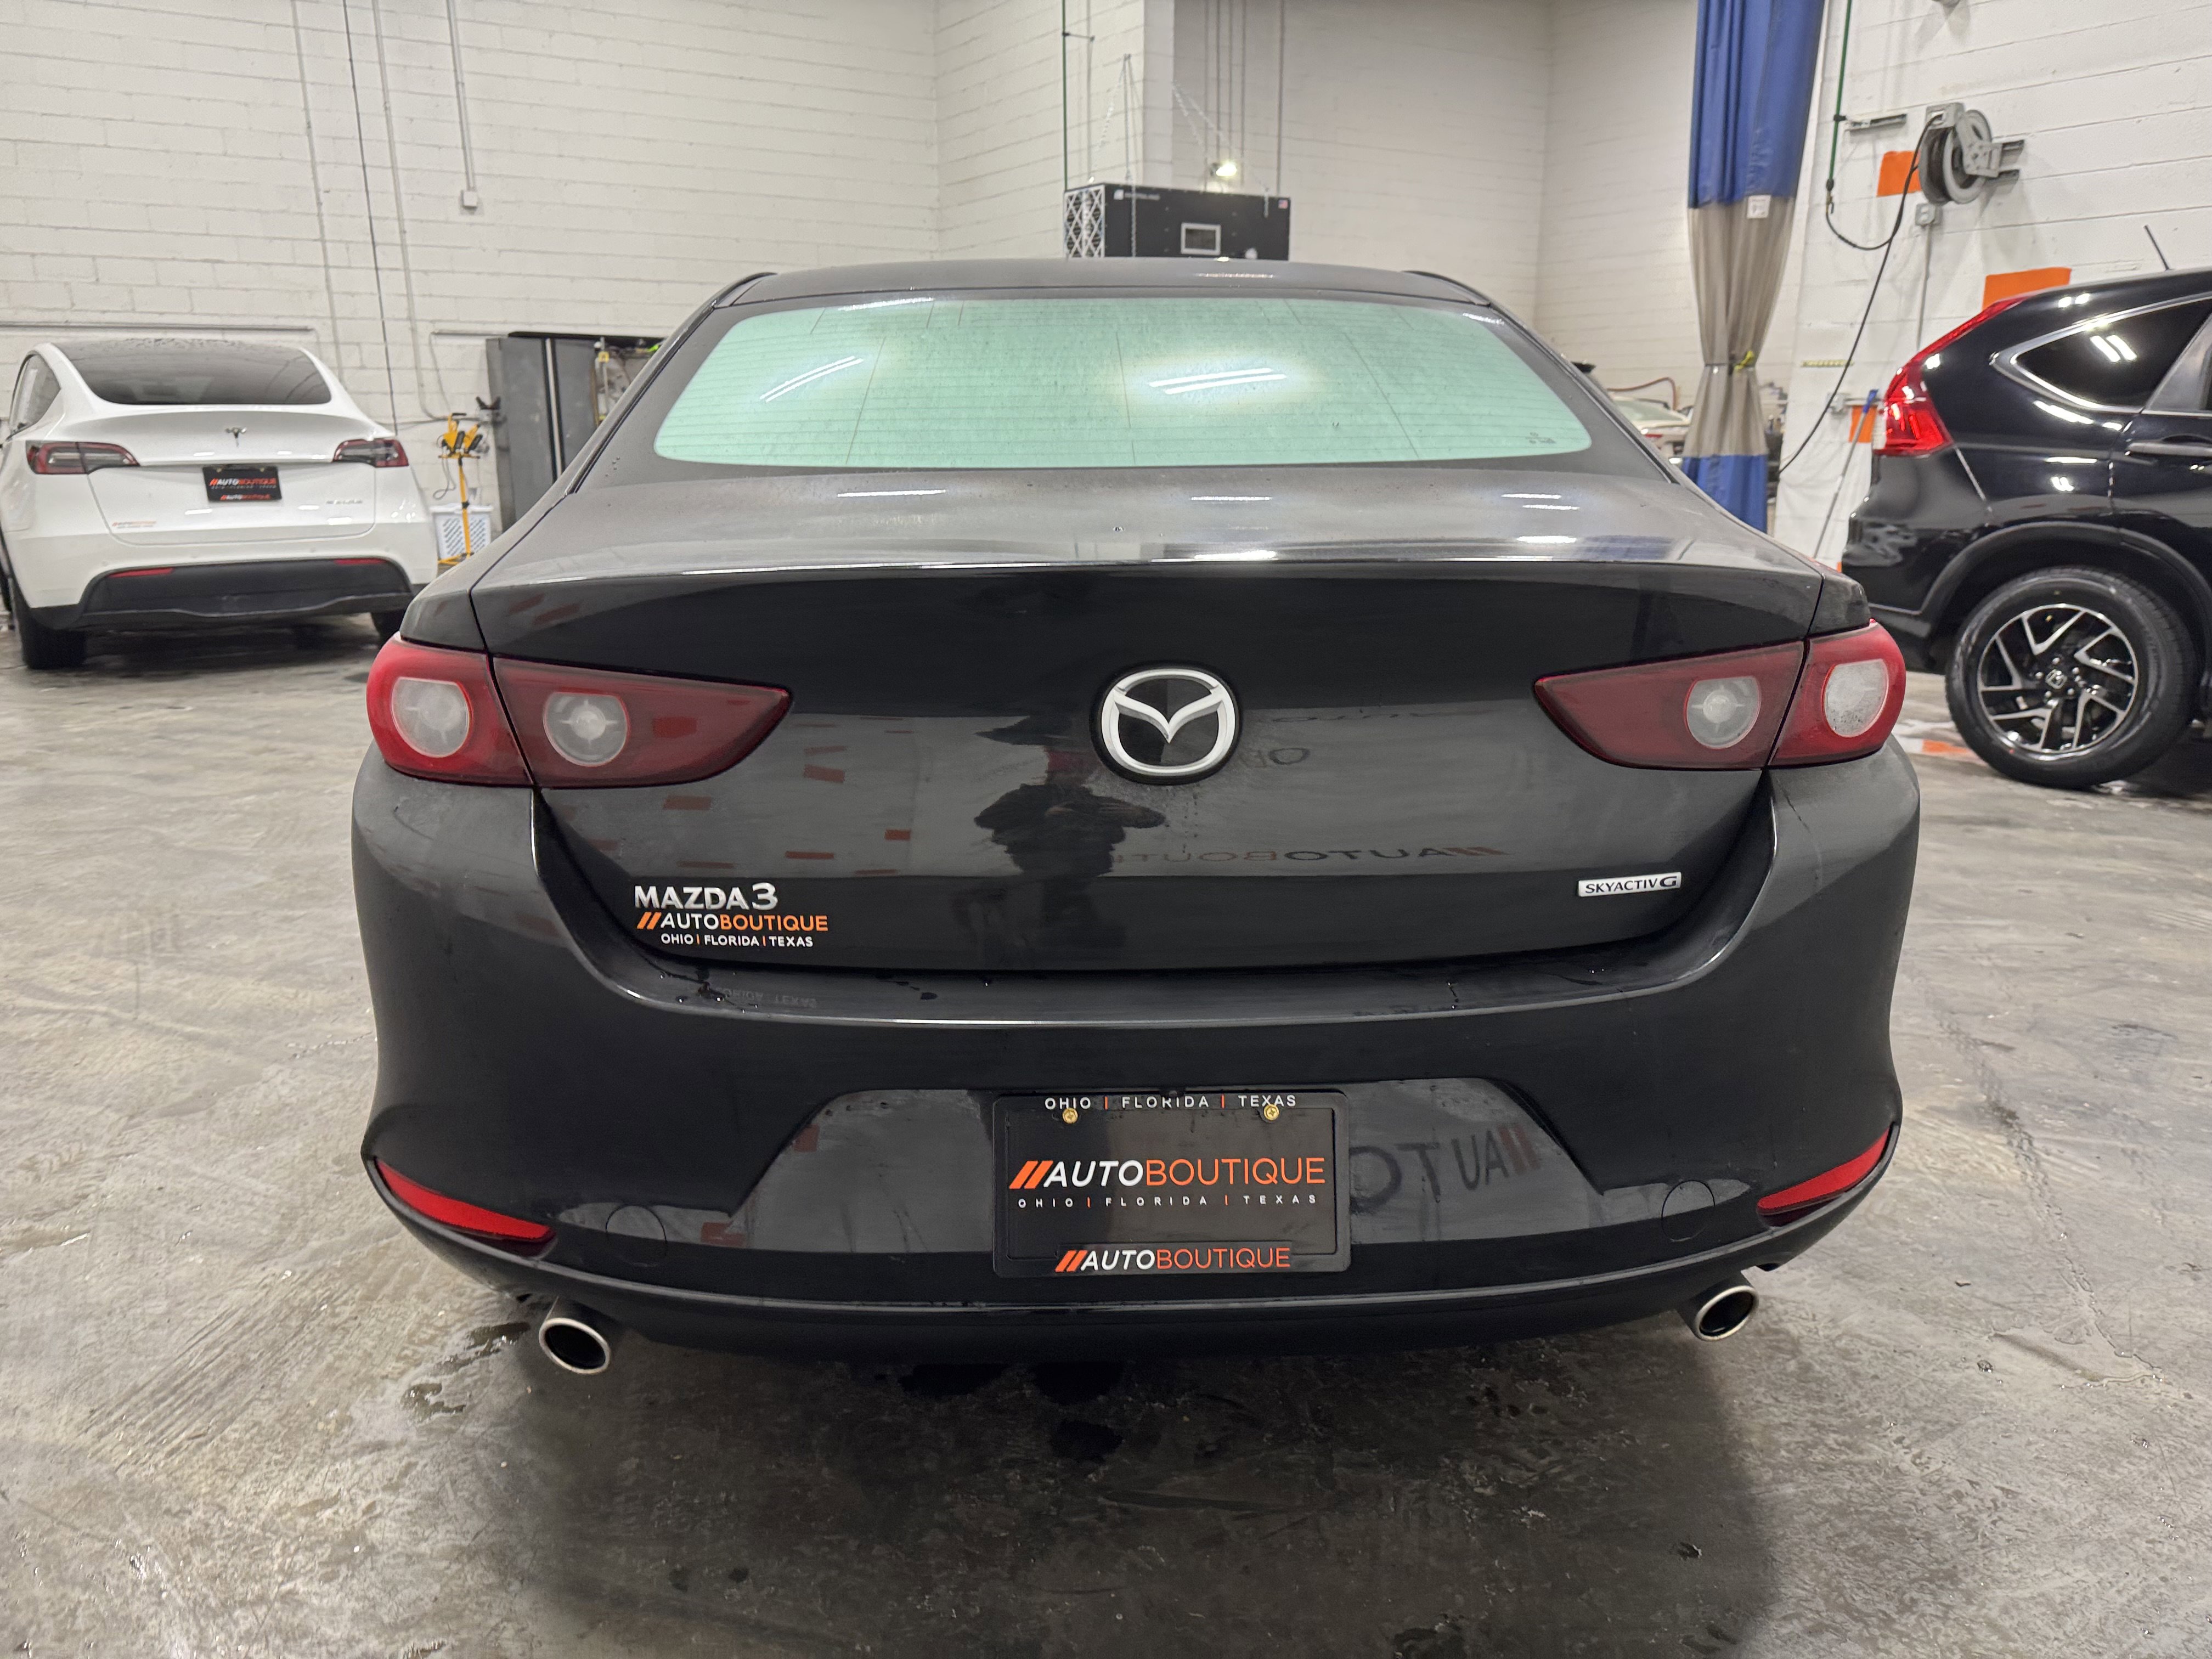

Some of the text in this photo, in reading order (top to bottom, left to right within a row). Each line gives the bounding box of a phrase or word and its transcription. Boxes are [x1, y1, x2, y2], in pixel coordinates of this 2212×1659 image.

[660, 912, 828, 932] AUTOBOUTIQUE
[661, 933, 814, 947] OHIO FLORIDA TEXAS
[1044, 1094, 1297, 1110] OHIO FLORIDA TEXAS
[1042, 1156, 1326, 1188] AUTOBOUTIQUE
[1018, 1194, 1317, 1209] OHIO FLORIDA TEXAS
[1080, 1246, 1291, 1271] AUTOBOUTIQUE
